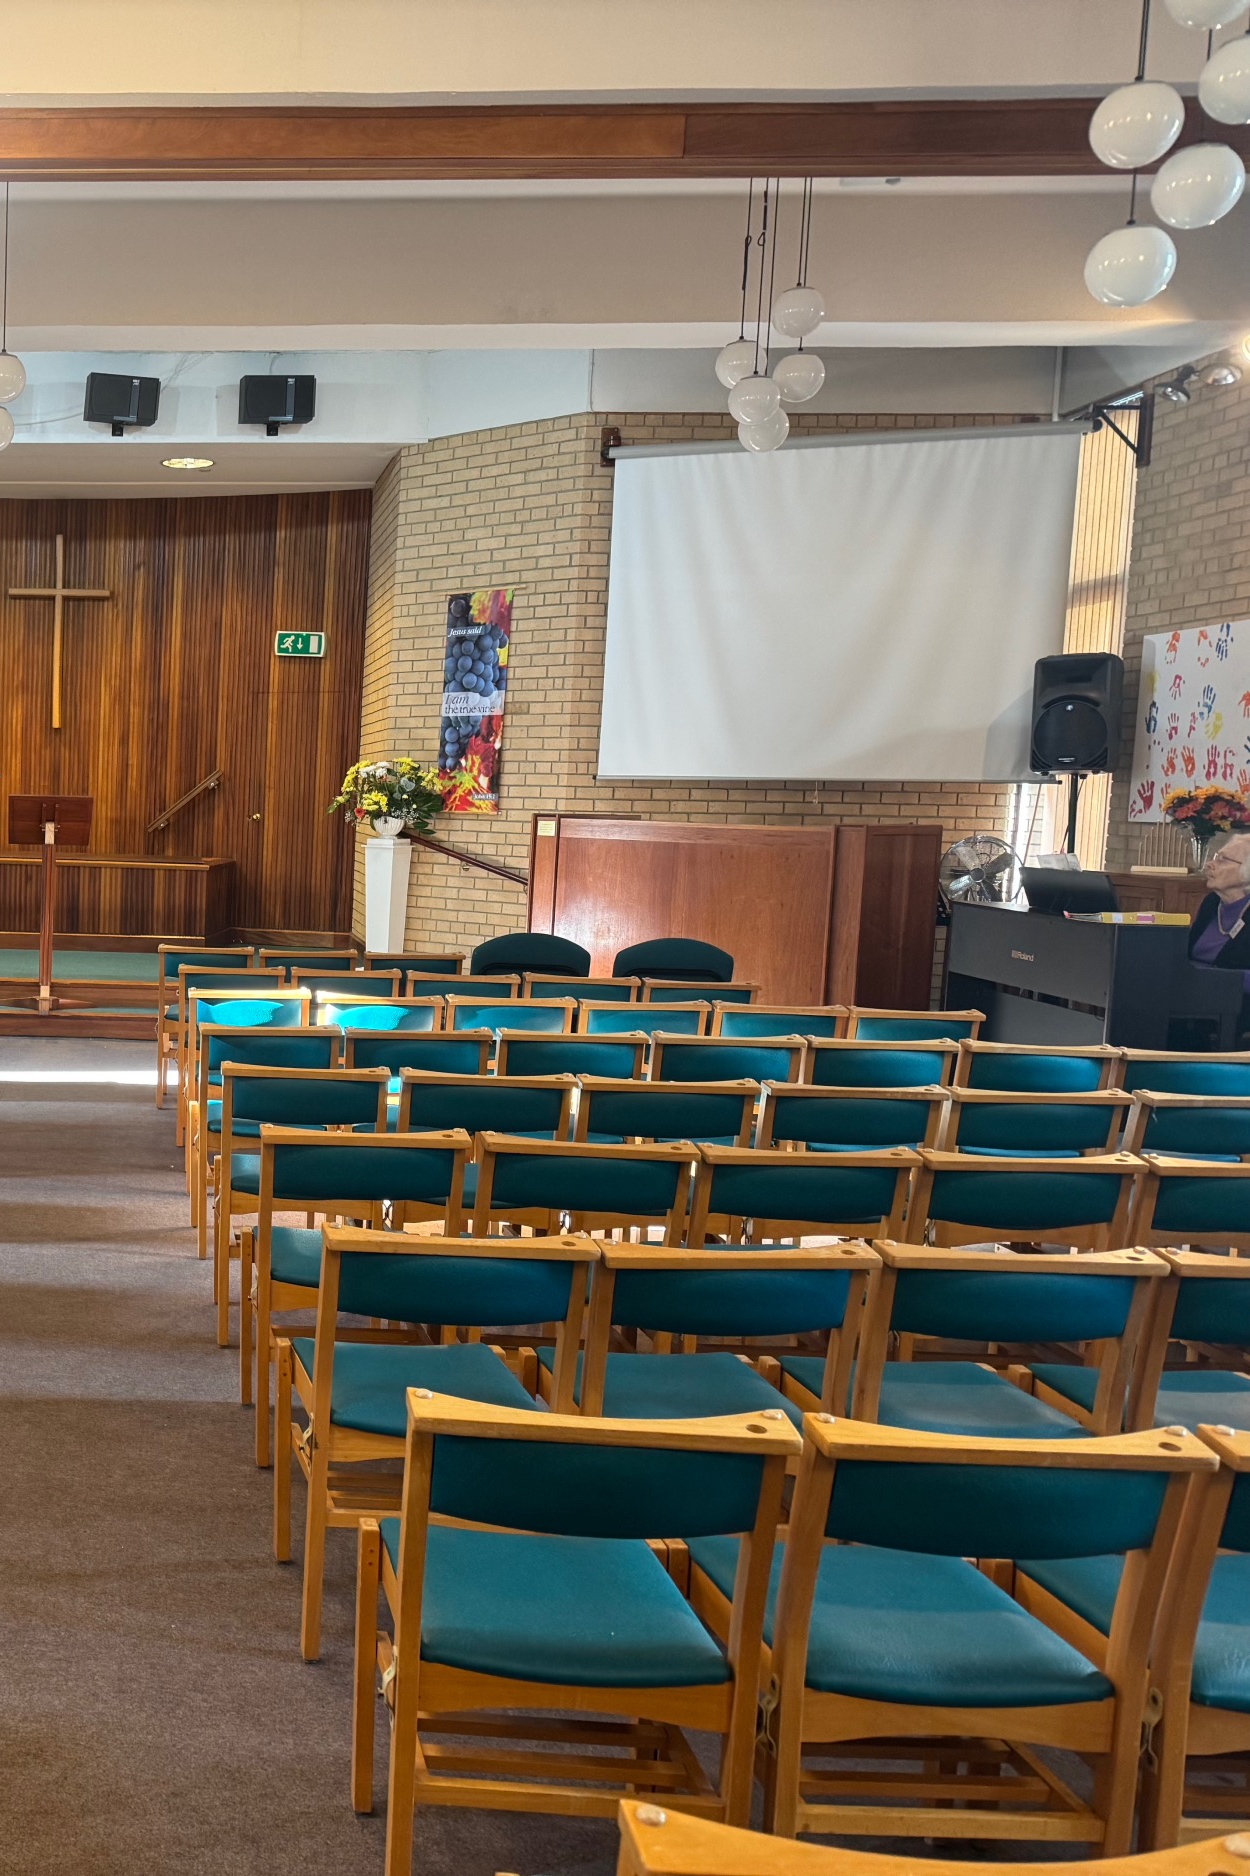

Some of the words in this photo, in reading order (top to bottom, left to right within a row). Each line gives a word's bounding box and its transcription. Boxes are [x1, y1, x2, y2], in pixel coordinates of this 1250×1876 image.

[448, 628, 466, 637] Jesus
[467, 626, 482, 635] said
[445, 695, 450, 704] I
[452, 696, 469, 704] am
[445, 705, 459, 714] the
[459, 706, 476, 714] true
[477, 705, 496, 713] vine
